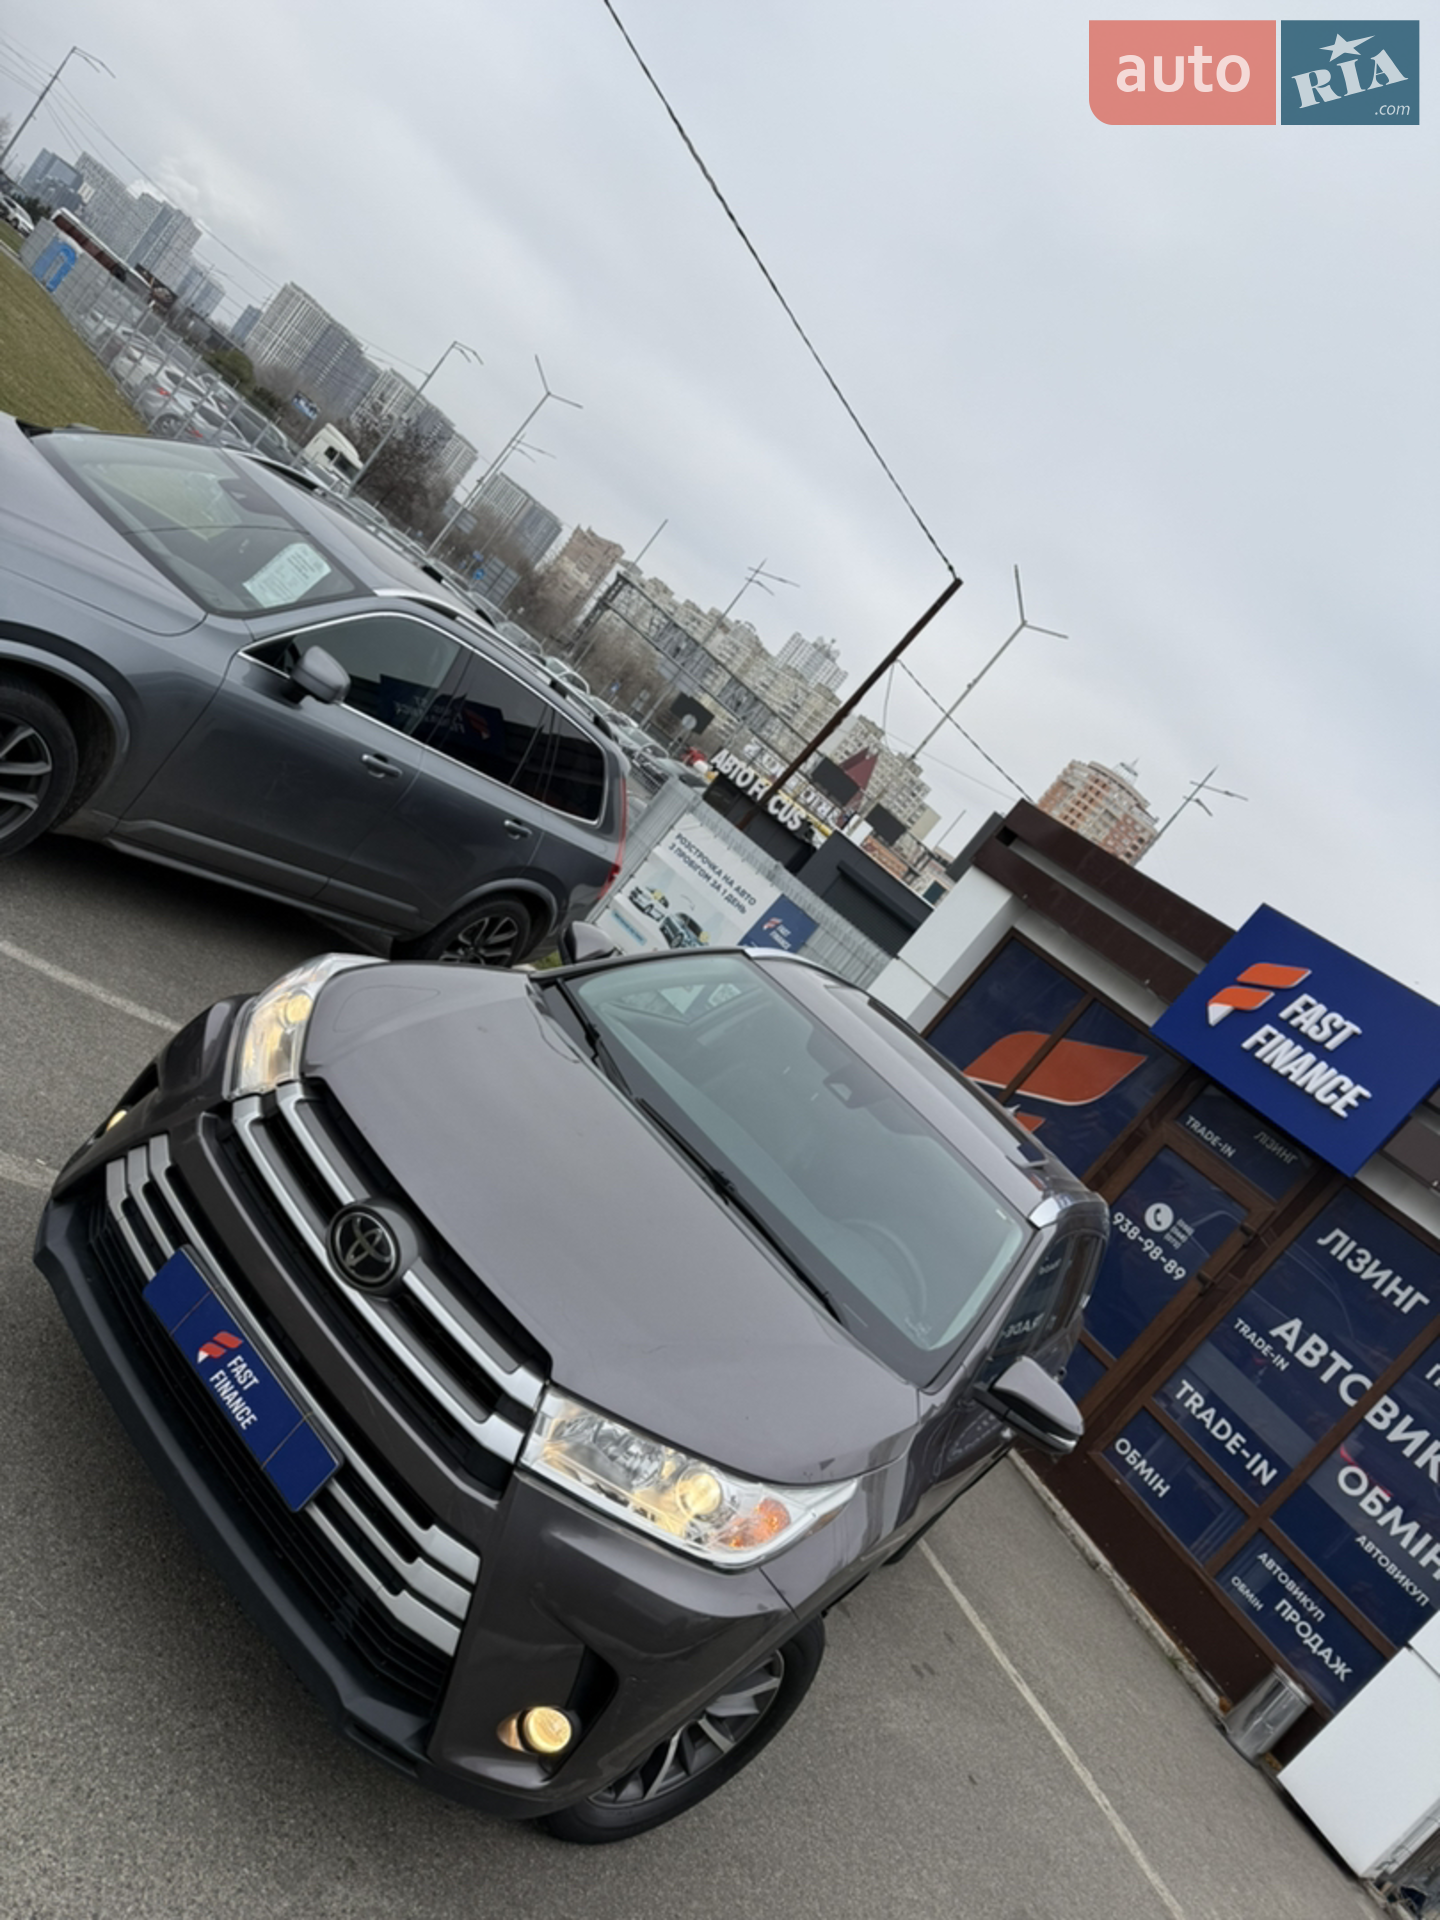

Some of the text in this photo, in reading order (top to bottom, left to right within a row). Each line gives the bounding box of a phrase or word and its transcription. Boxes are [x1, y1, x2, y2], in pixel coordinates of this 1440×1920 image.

[750, 780, 805, 831] FCUS
[675, 832, 758, 907] РОЗСТРОЧКА НА АВТО
[723, 894, 748, 916] ДЕНЬ
[1278, 992, 1363, 1051] FAST
[1240, 1023, 1373, 1119] FINANCE
[1185, 1114, 1237, 1159] TRADE-IN
[1253, 1129, 1299, 1166] ЛІЗИНГ
[1111, 1211, 1187, 1282] 938-98-89
[1316, 1227, 1431, 1316] ЛІЗИНГ
[226, 1354, 260, 1391] FAST
[1233, 1316, 1290, 1372] TRADE-IN
[209, 1369, 259, 1430] FINANCE
[1174, 1379, 1278, 1487] TRADE-IN
[1114, 1437, 1171, 1499] ОБМІН
[1337, 1464, 1440, 1582] ОБМІН
[1230, 1574, 1265, 1612] ОБМІН
[1256, 1551, 1326, 1623] АВТОВИКУП
[1354, 1533, 1431, 1608] АВТОВИКУП
[1274, 1598, 1354, 1684] ПРОДАЖ
